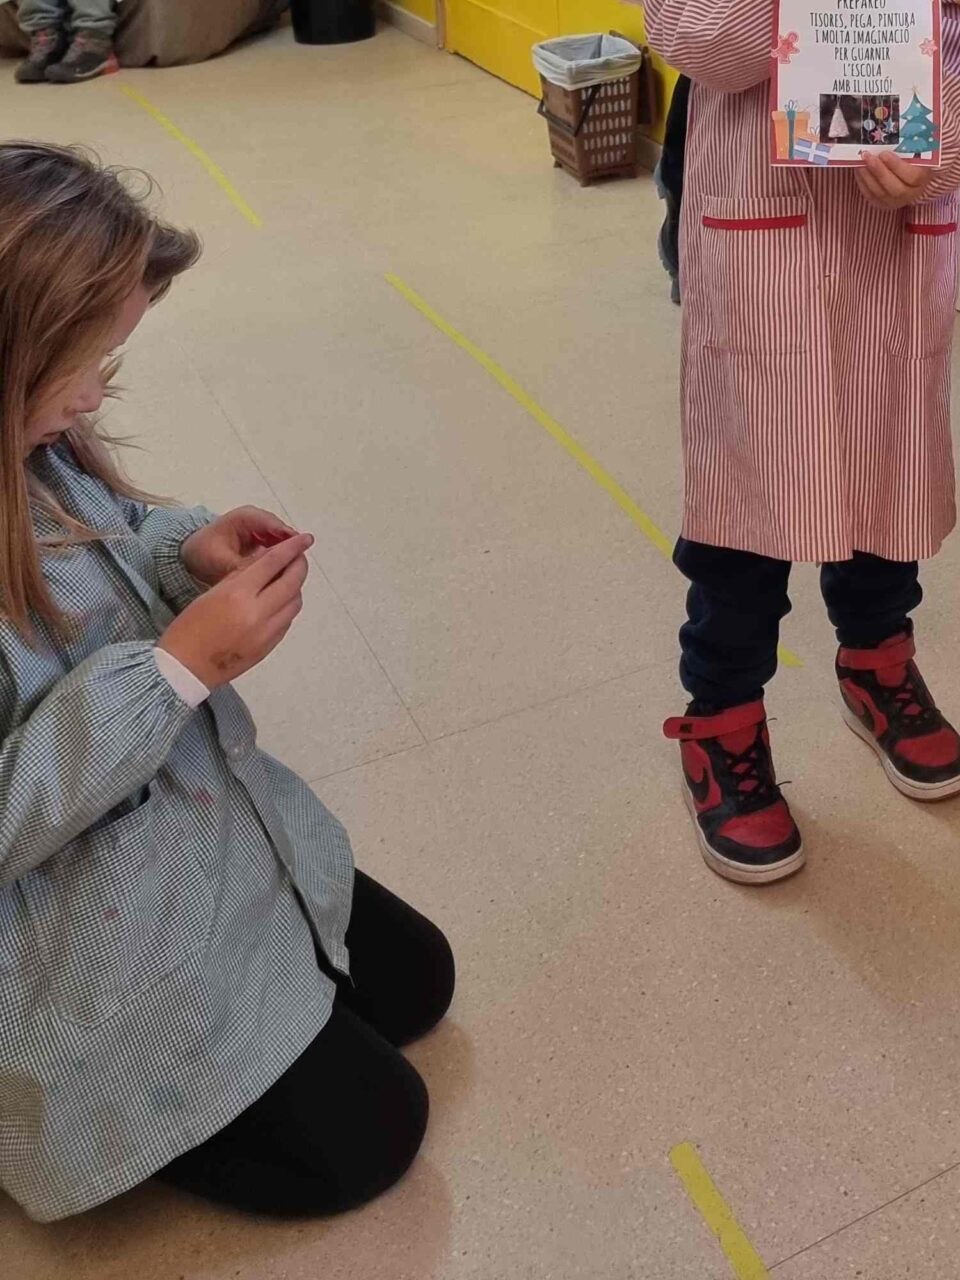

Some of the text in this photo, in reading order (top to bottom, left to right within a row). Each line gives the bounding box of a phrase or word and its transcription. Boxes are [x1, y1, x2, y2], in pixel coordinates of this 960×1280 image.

[810, 12, 915, 29] TISORES, PEGA, PINTURA
[815, 26, 910, 45] I MOLTA IMAGINACIÓ
[834, 46, 890, 61] PER GUARNIR
[843, 63, 882, 78] L'ESCOLA
[832, 79, 850, 93] AMB
